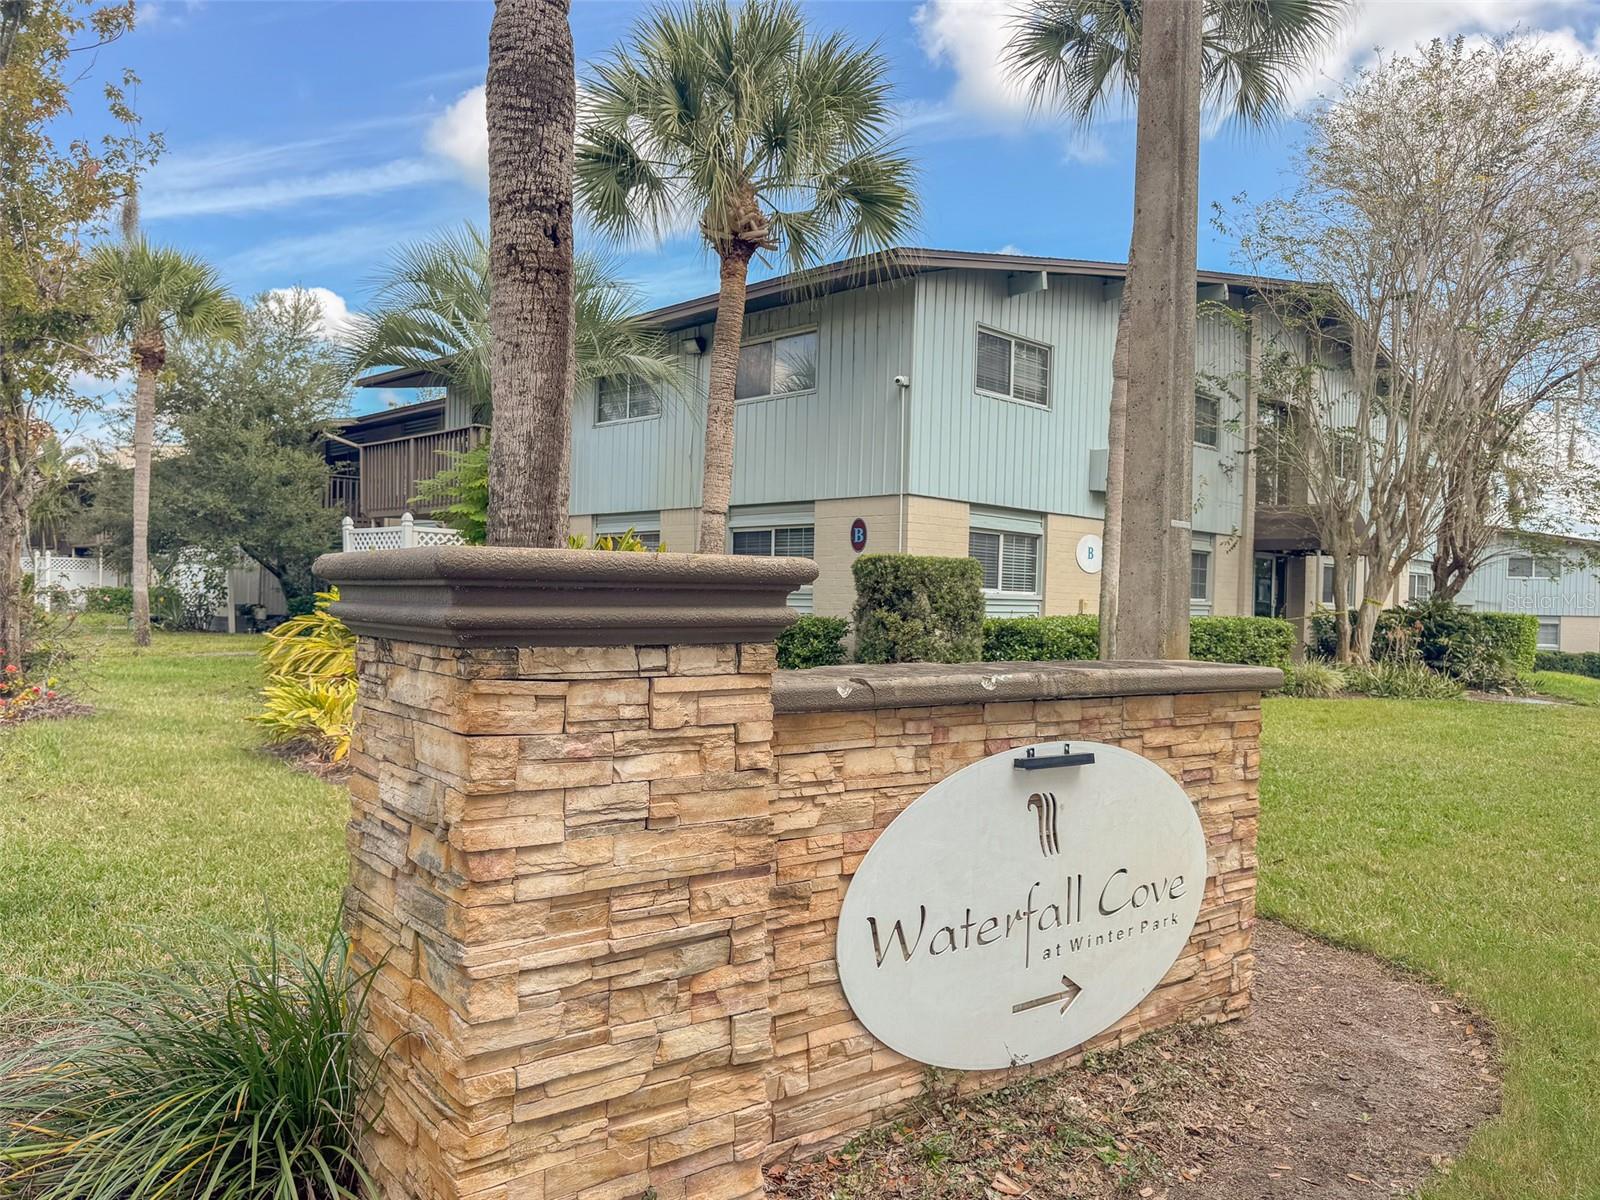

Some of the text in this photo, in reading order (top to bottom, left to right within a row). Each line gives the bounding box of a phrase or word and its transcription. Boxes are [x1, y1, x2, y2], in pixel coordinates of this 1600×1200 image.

[853, 527, 864, 543] B
[1087, 546, 1094, 560] B
[866, 868, 1186, 969] Waterfall Cove
[1042, 912, 1180, 961] at Winter Park
